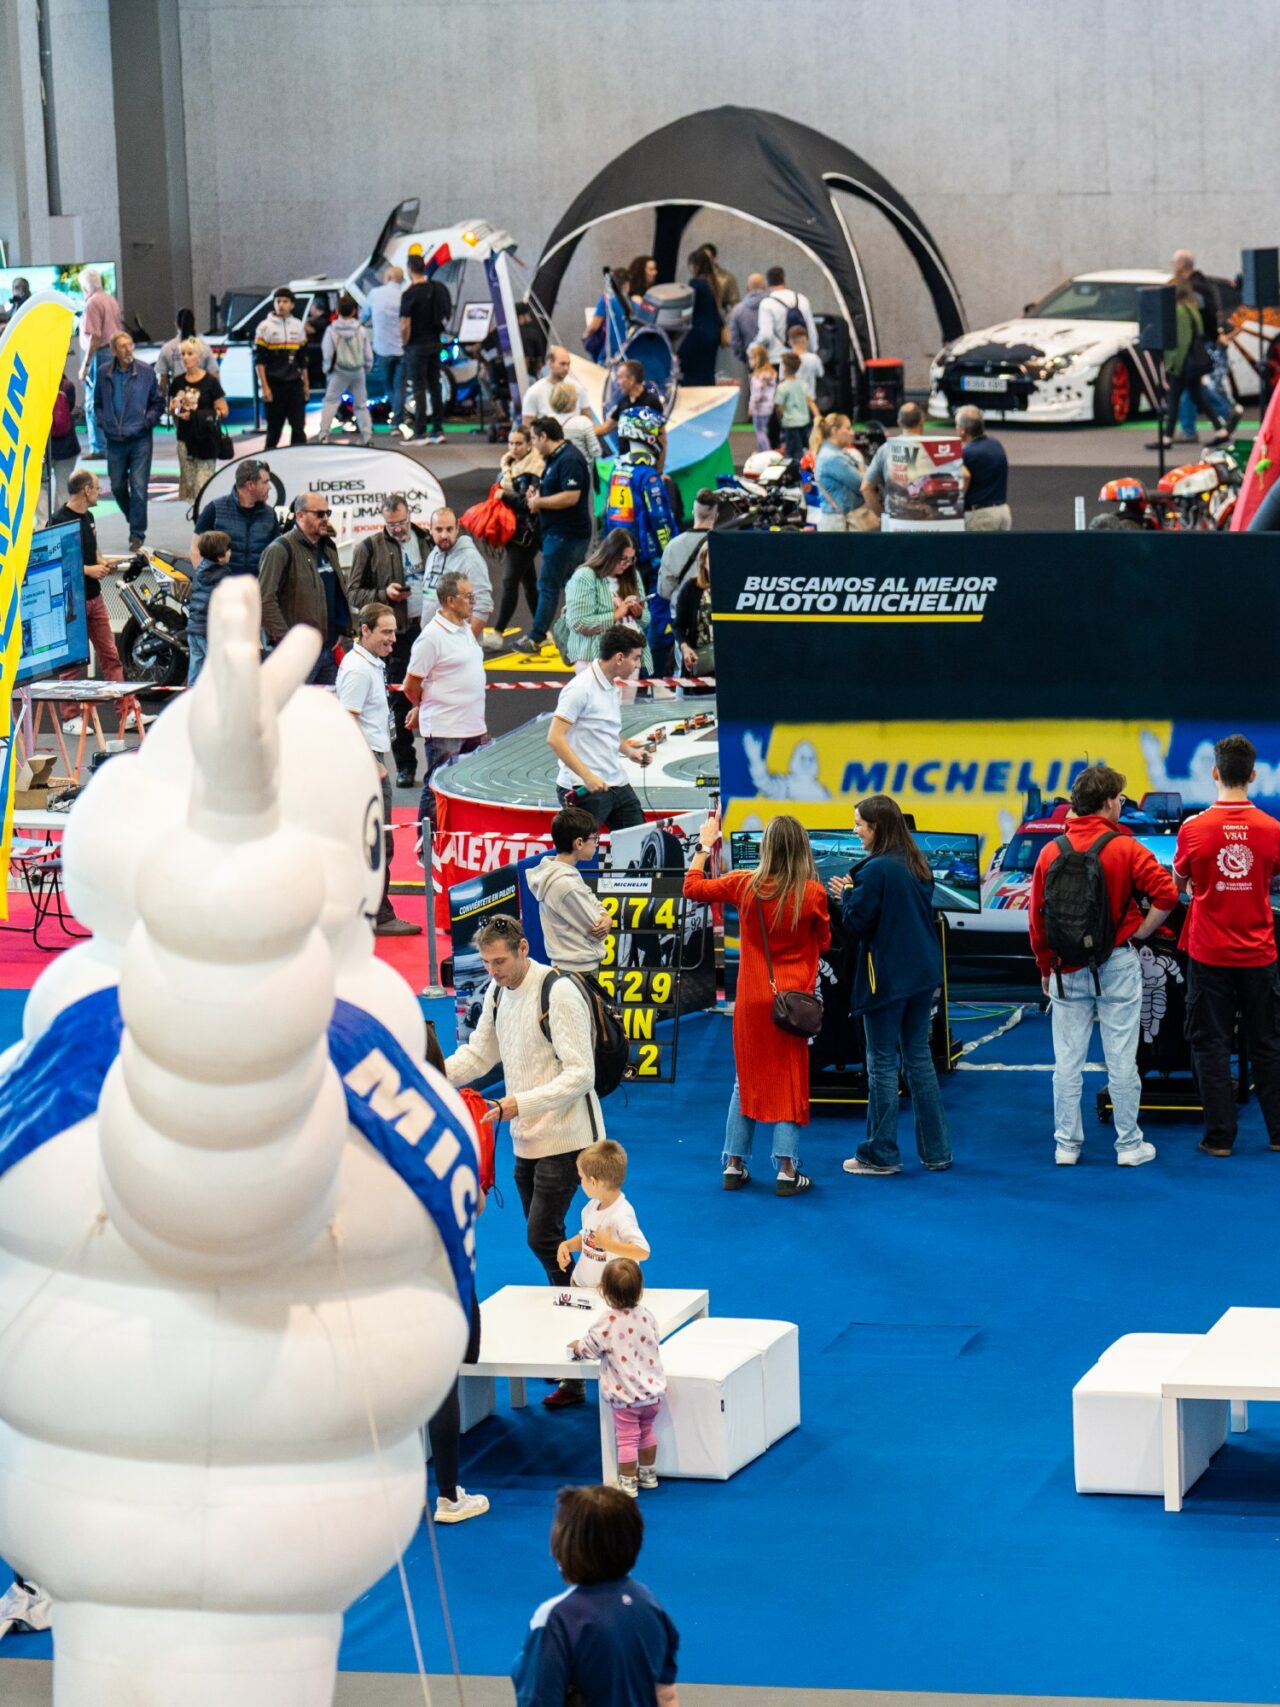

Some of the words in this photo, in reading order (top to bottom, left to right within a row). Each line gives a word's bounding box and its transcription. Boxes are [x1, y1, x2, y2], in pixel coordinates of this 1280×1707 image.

[309, 478, 365, 492] LÍDERES
[744, 576, 875, 592] BUSCAMOS
[879, 577, 909, 592] AL
[914, 577, 997, 592] MEJOR
[736, 593, 838, 611] PILOTO
[842, 594, 987, 612] MICHELIN
[639, 1044, 659, 1076] 2
[343, 1047, 477, 1273] MIC
